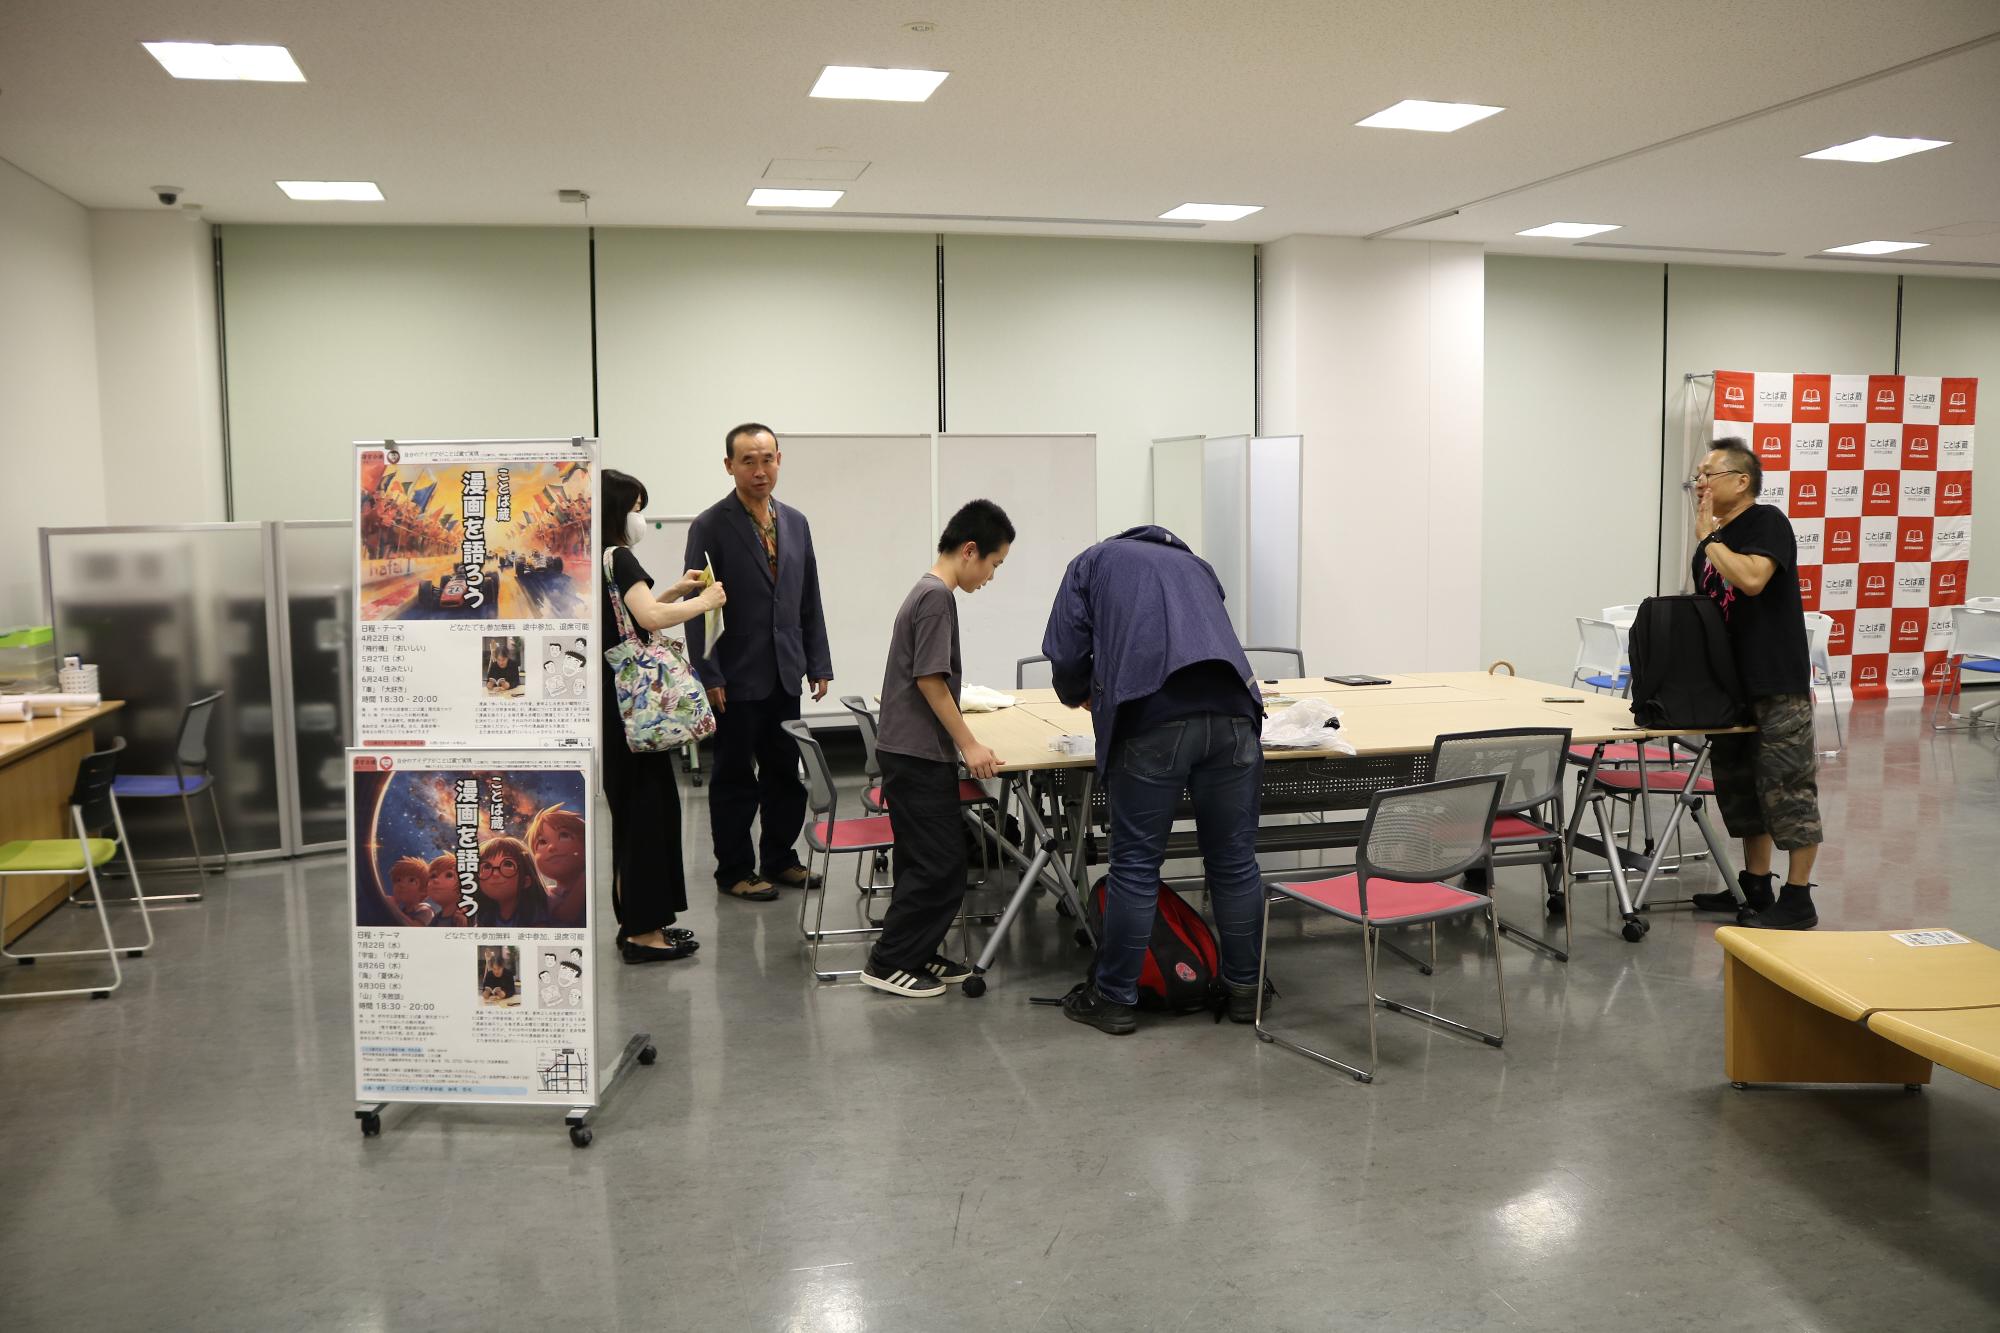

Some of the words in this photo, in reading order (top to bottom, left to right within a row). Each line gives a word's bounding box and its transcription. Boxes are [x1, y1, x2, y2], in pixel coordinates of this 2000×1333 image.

[462, 470, 486, 608] 漫画を語ろう
[361, 624, 404, 632] 日程・テーマ
[449, 623, 516, 632] どなたでも参加無料
[361, 696, 376, 704] 時間
[456, 779, 480, 918] 漫画を語ろう
[444, 932, 511, 940] どなたでも参加無料
